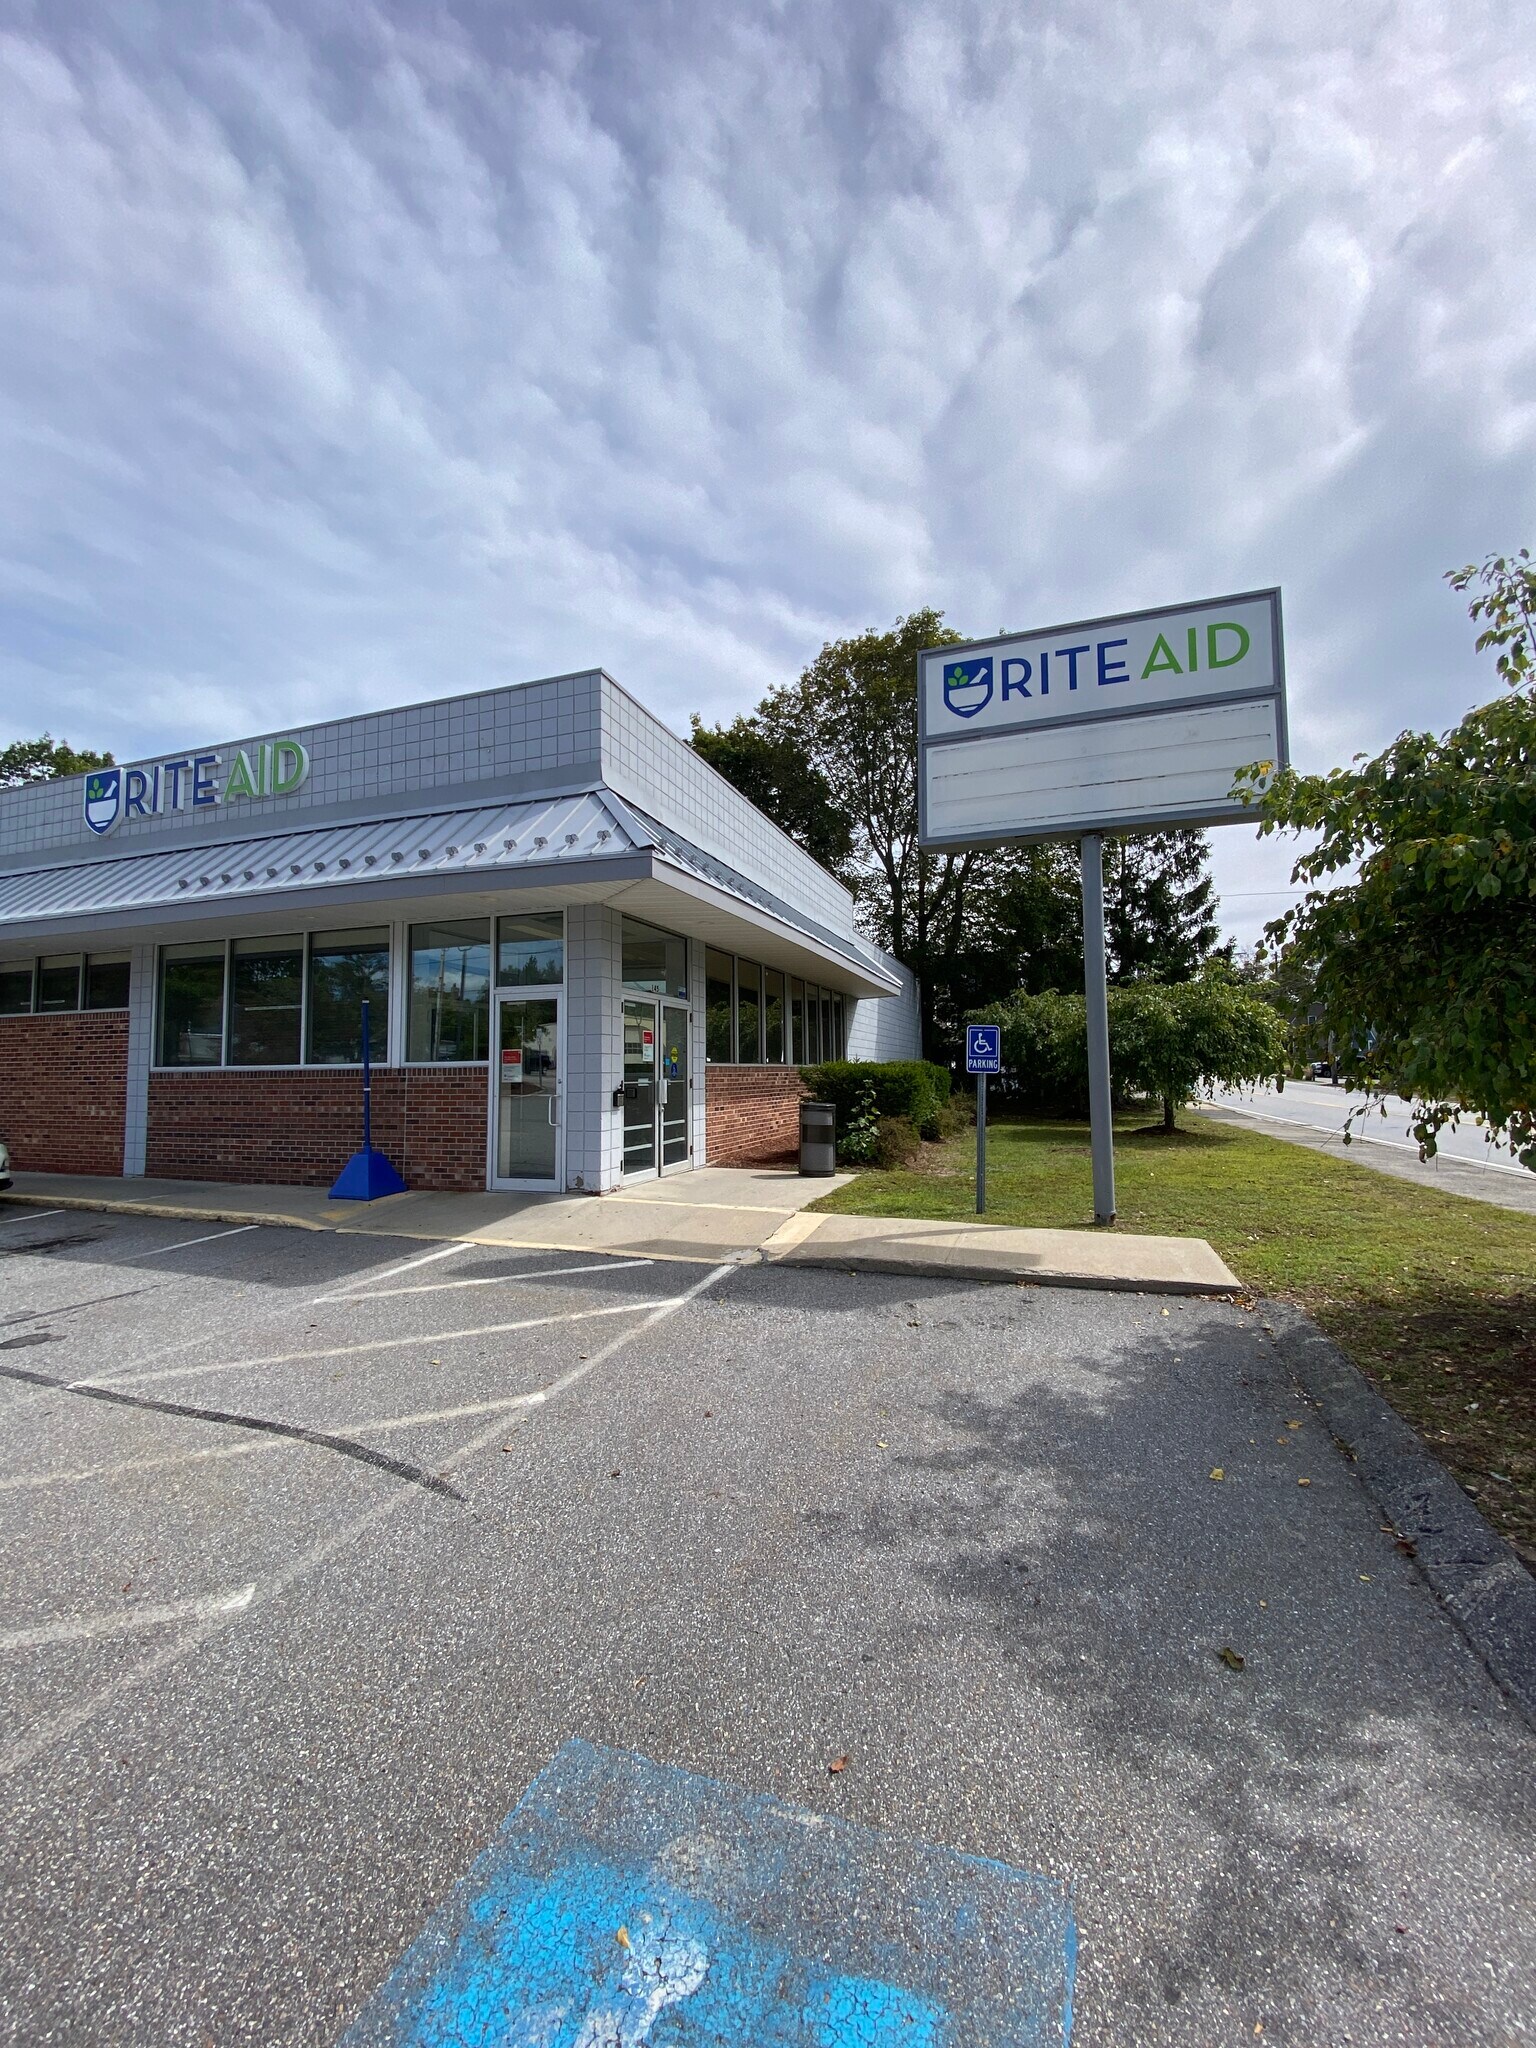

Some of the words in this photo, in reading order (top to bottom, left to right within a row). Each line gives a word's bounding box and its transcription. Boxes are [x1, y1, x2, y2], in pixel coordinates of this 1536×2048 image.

[1001, 638, 1130, 702] RITE
[1140, 622, 1250, 680] AID
[125, 754, 222, 819] RITE
[223, 740, 309, 802] AID
[968, 1059, 998, 1069] PARKING
